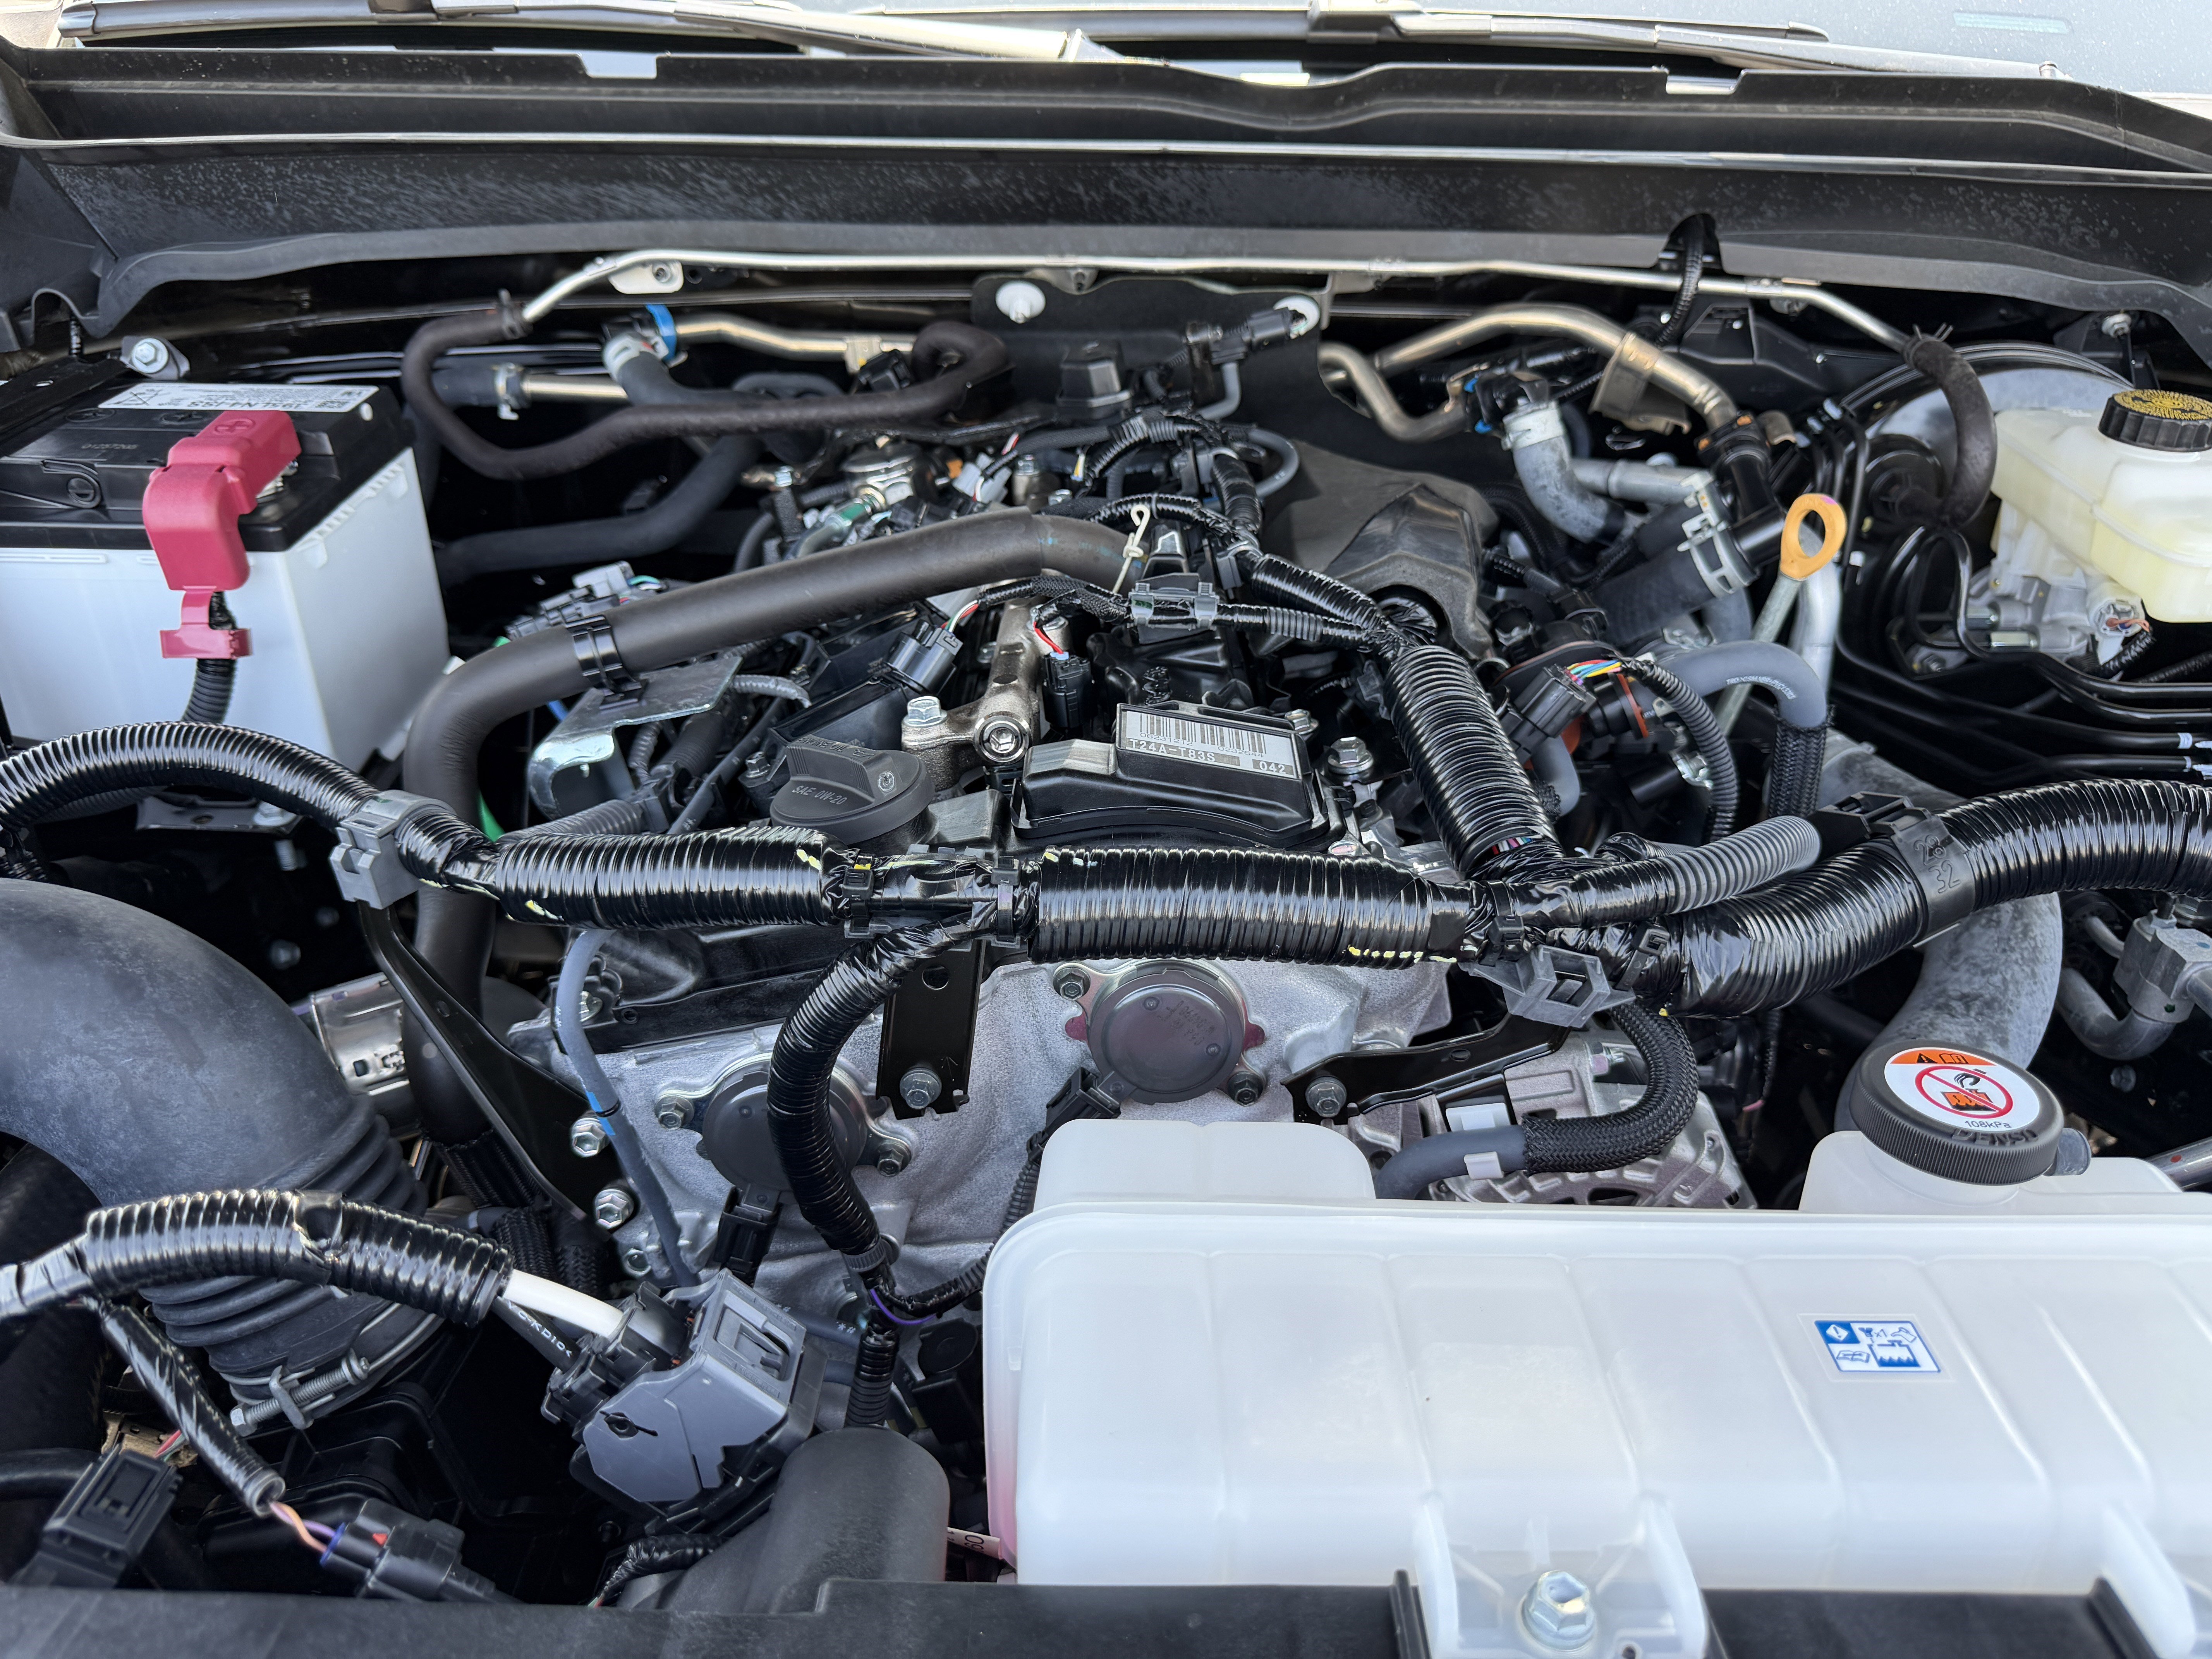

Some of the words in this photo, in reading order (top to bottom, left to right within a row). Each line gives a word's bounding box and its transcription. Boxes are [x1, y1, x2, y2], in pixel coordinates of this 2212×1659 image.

[798, 737, 830, 748] ENGINE
[831, 742, 848, 752] OIL
[1140, 732, 1193, 746] 06231212
[1130, 738, 1216, 763] T24A-T83S
[1218, 745, 1264, 758] 0232644
[1259, 761, 1286, 775] 042
[792, 785, 816, 795] SAE
[814, 789, 848, 805] 0W-20
[1913, 834, 1947, 866] 28
[1928, 860, 1961, 894] 32
[1965, 1120, 2011, 1128] 108kPa
[1952, 1128, 2039, 1146] DENSO
